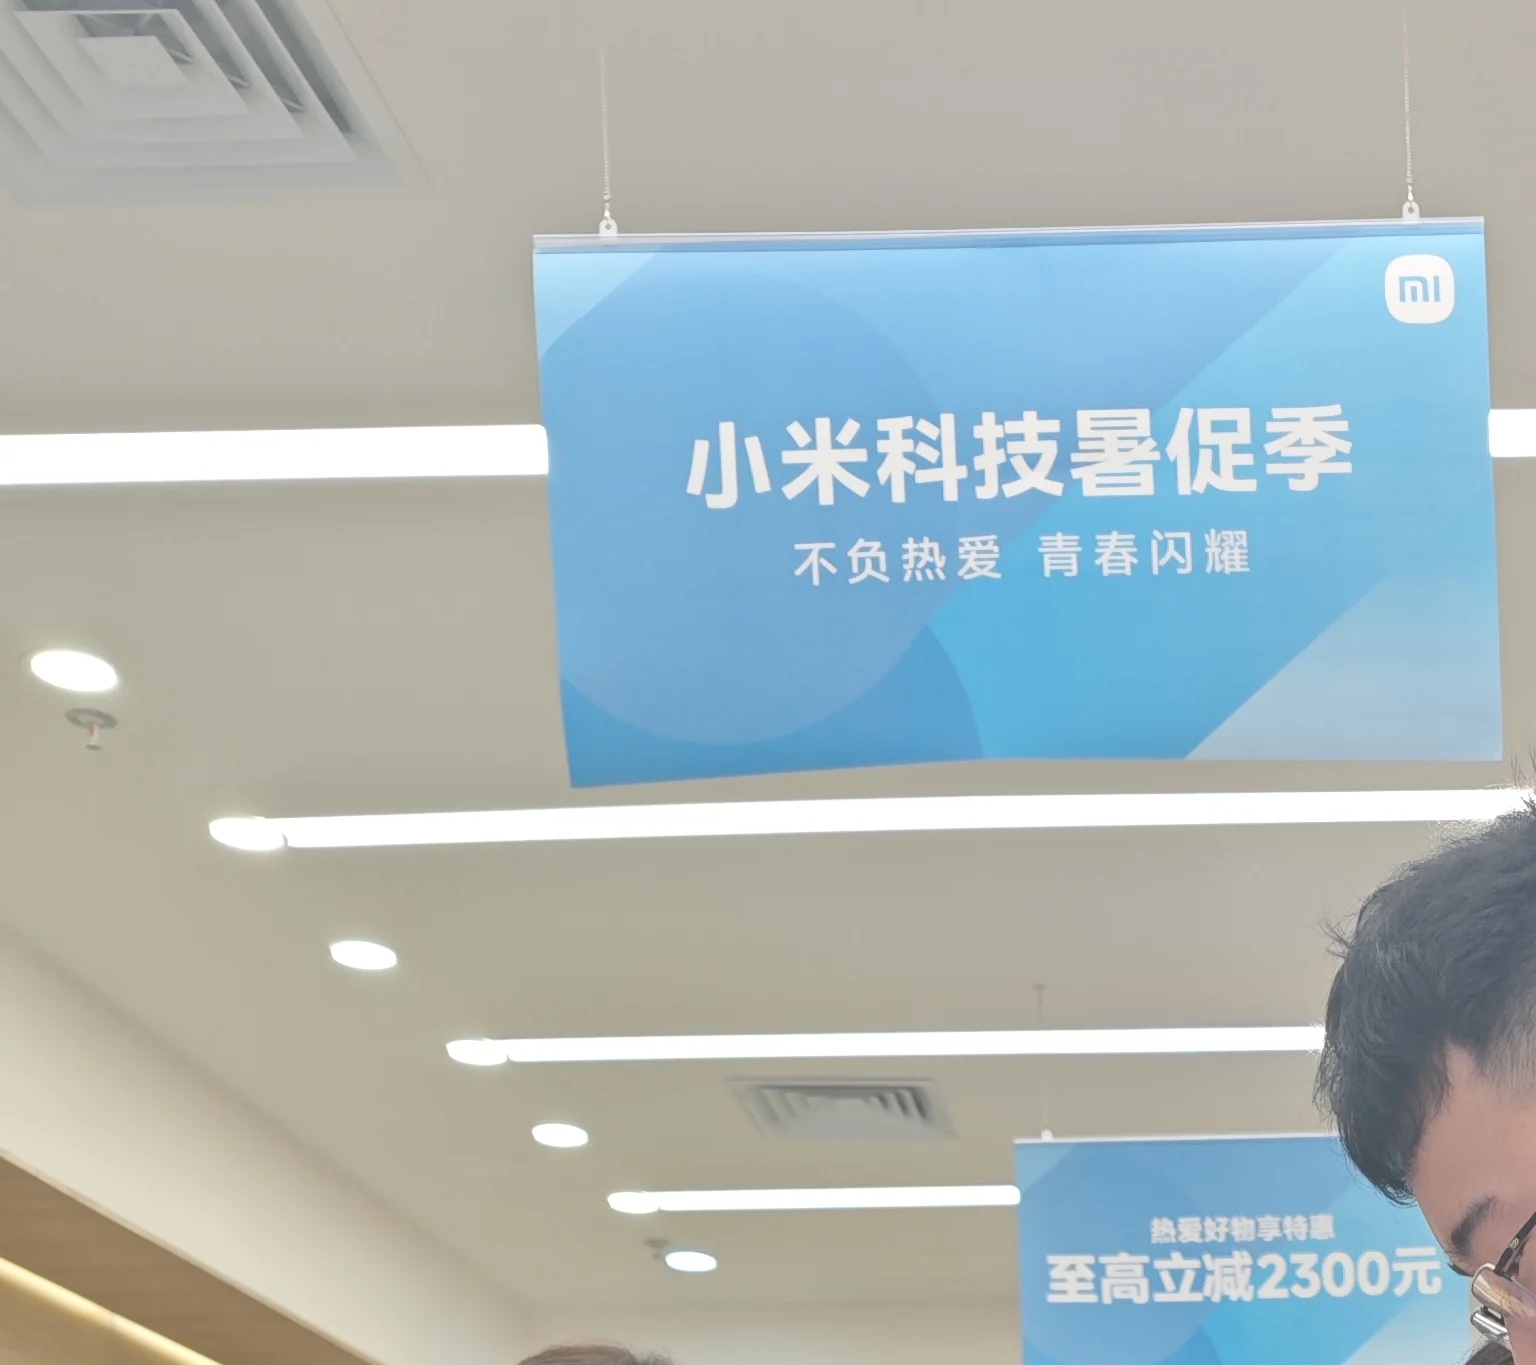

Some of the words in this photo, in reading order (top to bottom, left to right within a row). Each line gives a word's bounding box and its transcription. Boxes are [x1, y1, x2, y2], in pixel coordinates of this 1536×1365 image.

[685, 403, 1355, 511] 小米科技暑促季
[793, 532, 1003, 586] 不负热爱
[1037, 528, 1252, 579] 青春闪耀
[1150, 1214, 1336, 1245] 热爱好物享特惠
[1046, 1246, 1442, 1305] 至高立减2300元
